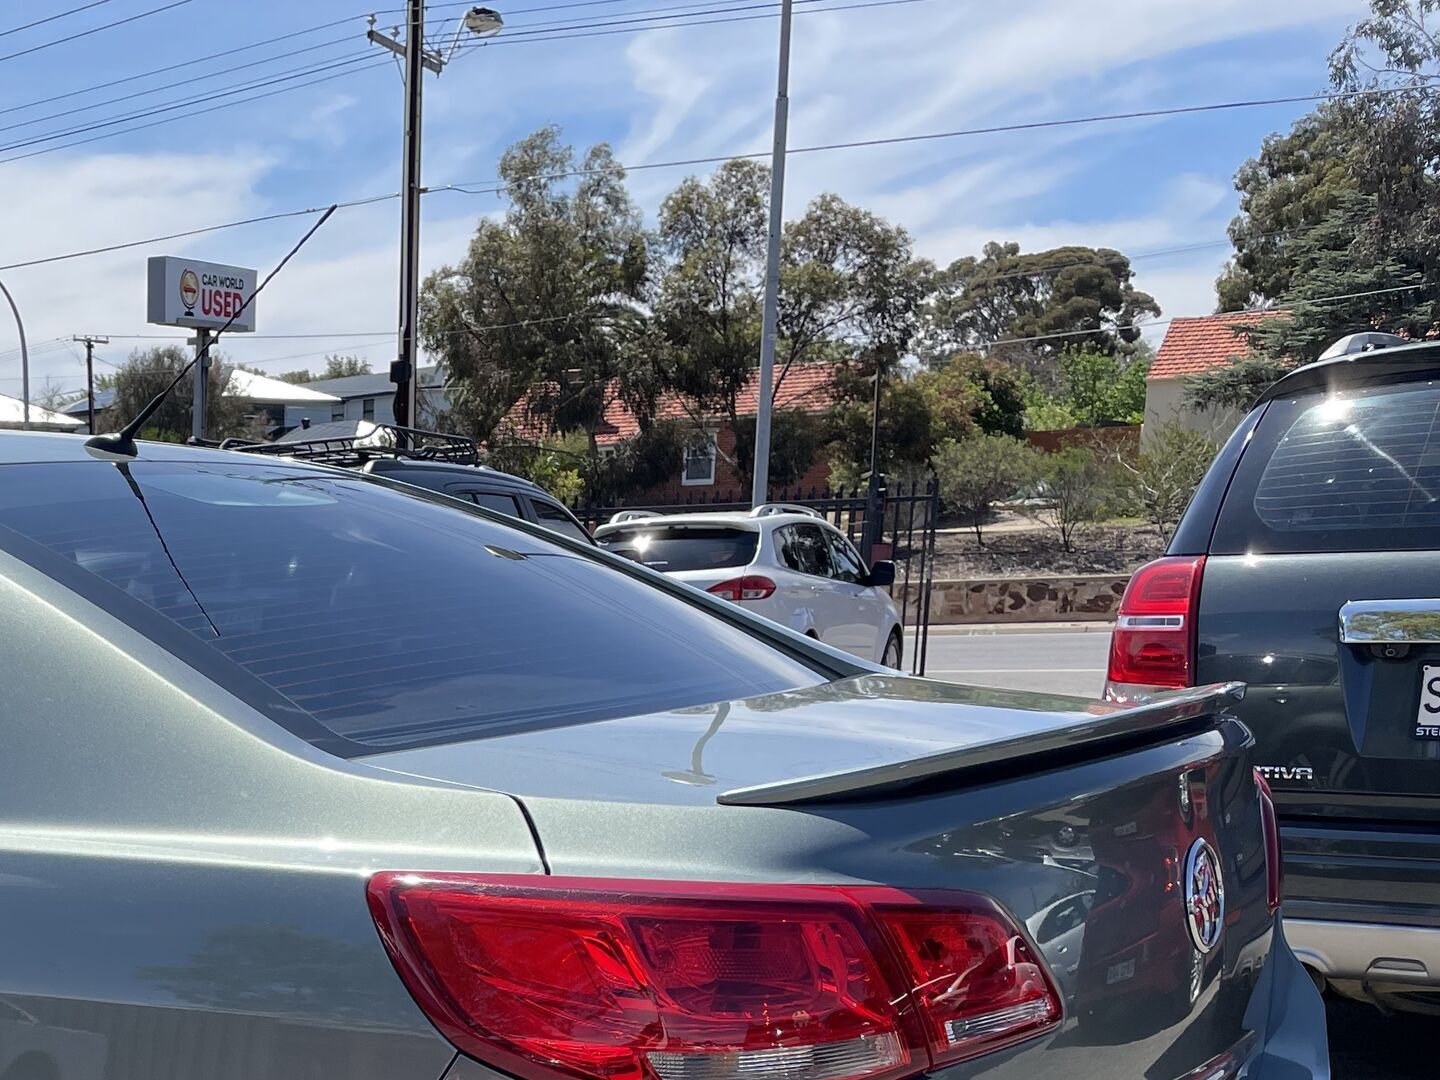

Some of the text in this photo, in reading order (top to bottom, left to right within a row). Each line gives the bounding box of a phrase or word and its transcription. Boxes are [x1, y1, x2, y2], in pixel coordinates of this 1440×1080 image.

[202, 274, 244, 290] CAR WORLD
[201, 288, 243, 319] USED
[1416, 727, 1440, 736] STE
